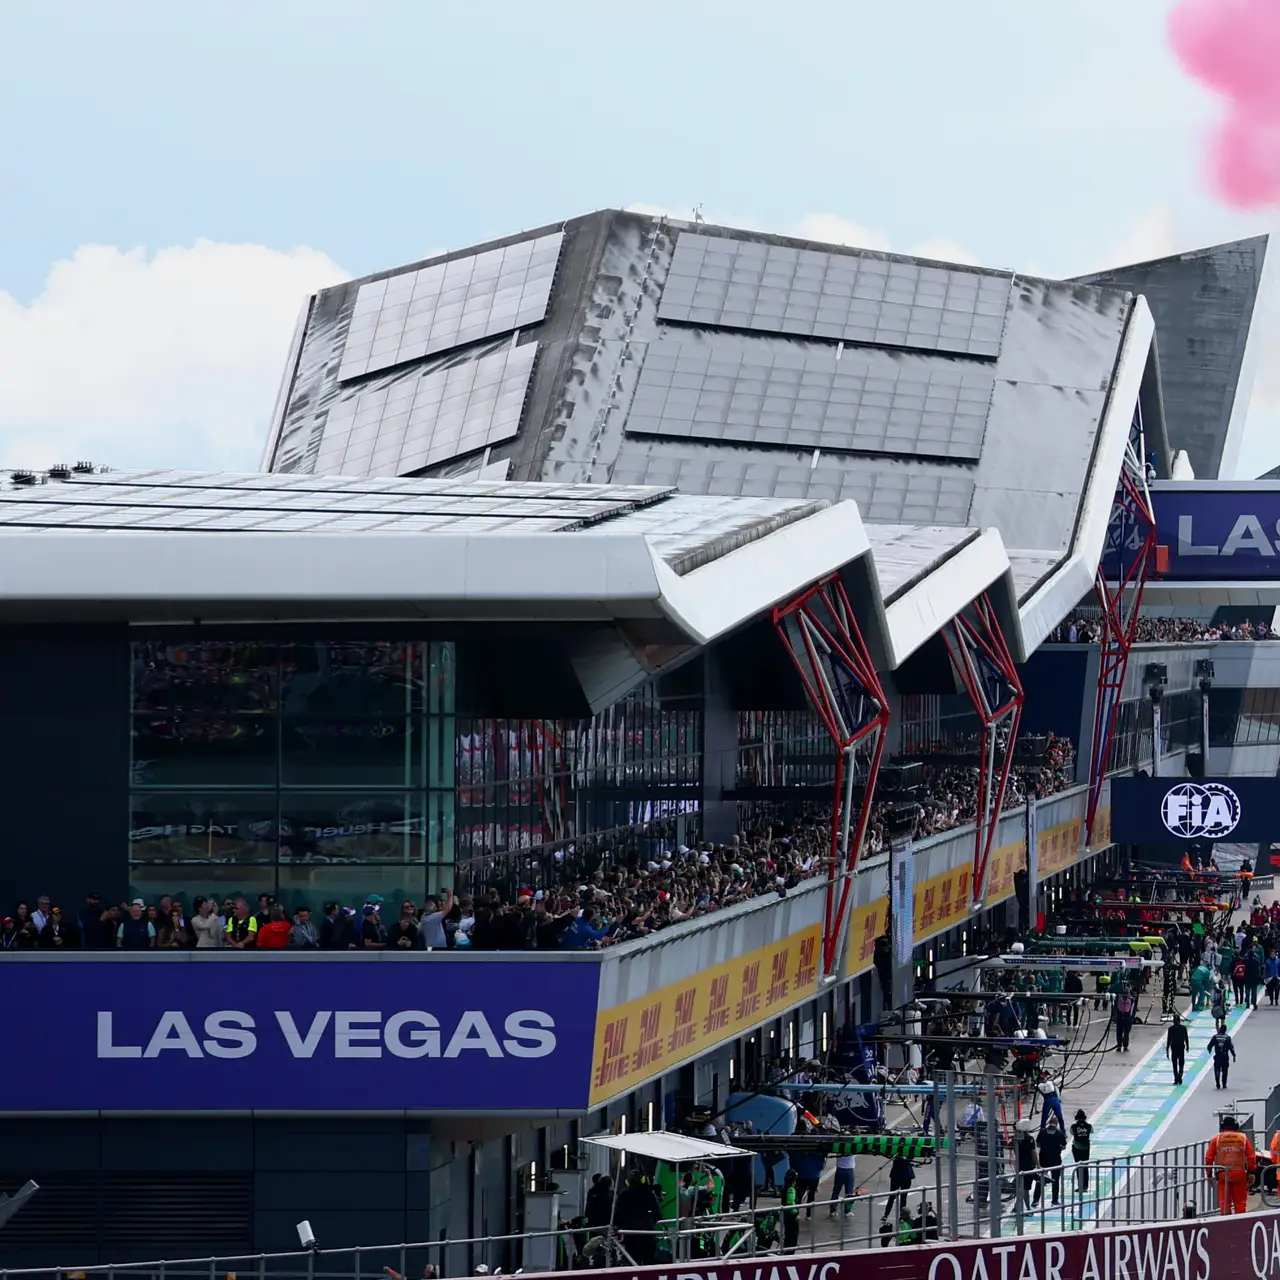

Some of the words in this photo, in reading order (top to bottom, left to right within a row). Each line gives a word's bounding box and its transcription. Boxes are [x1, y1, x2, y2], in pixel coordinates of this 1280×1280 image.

[98, 1011, 256, 1058] LAS
[274, 1010, 557, 1058] VEGAS
[1082, 1227, 1210, 1280] AIRWAYS
